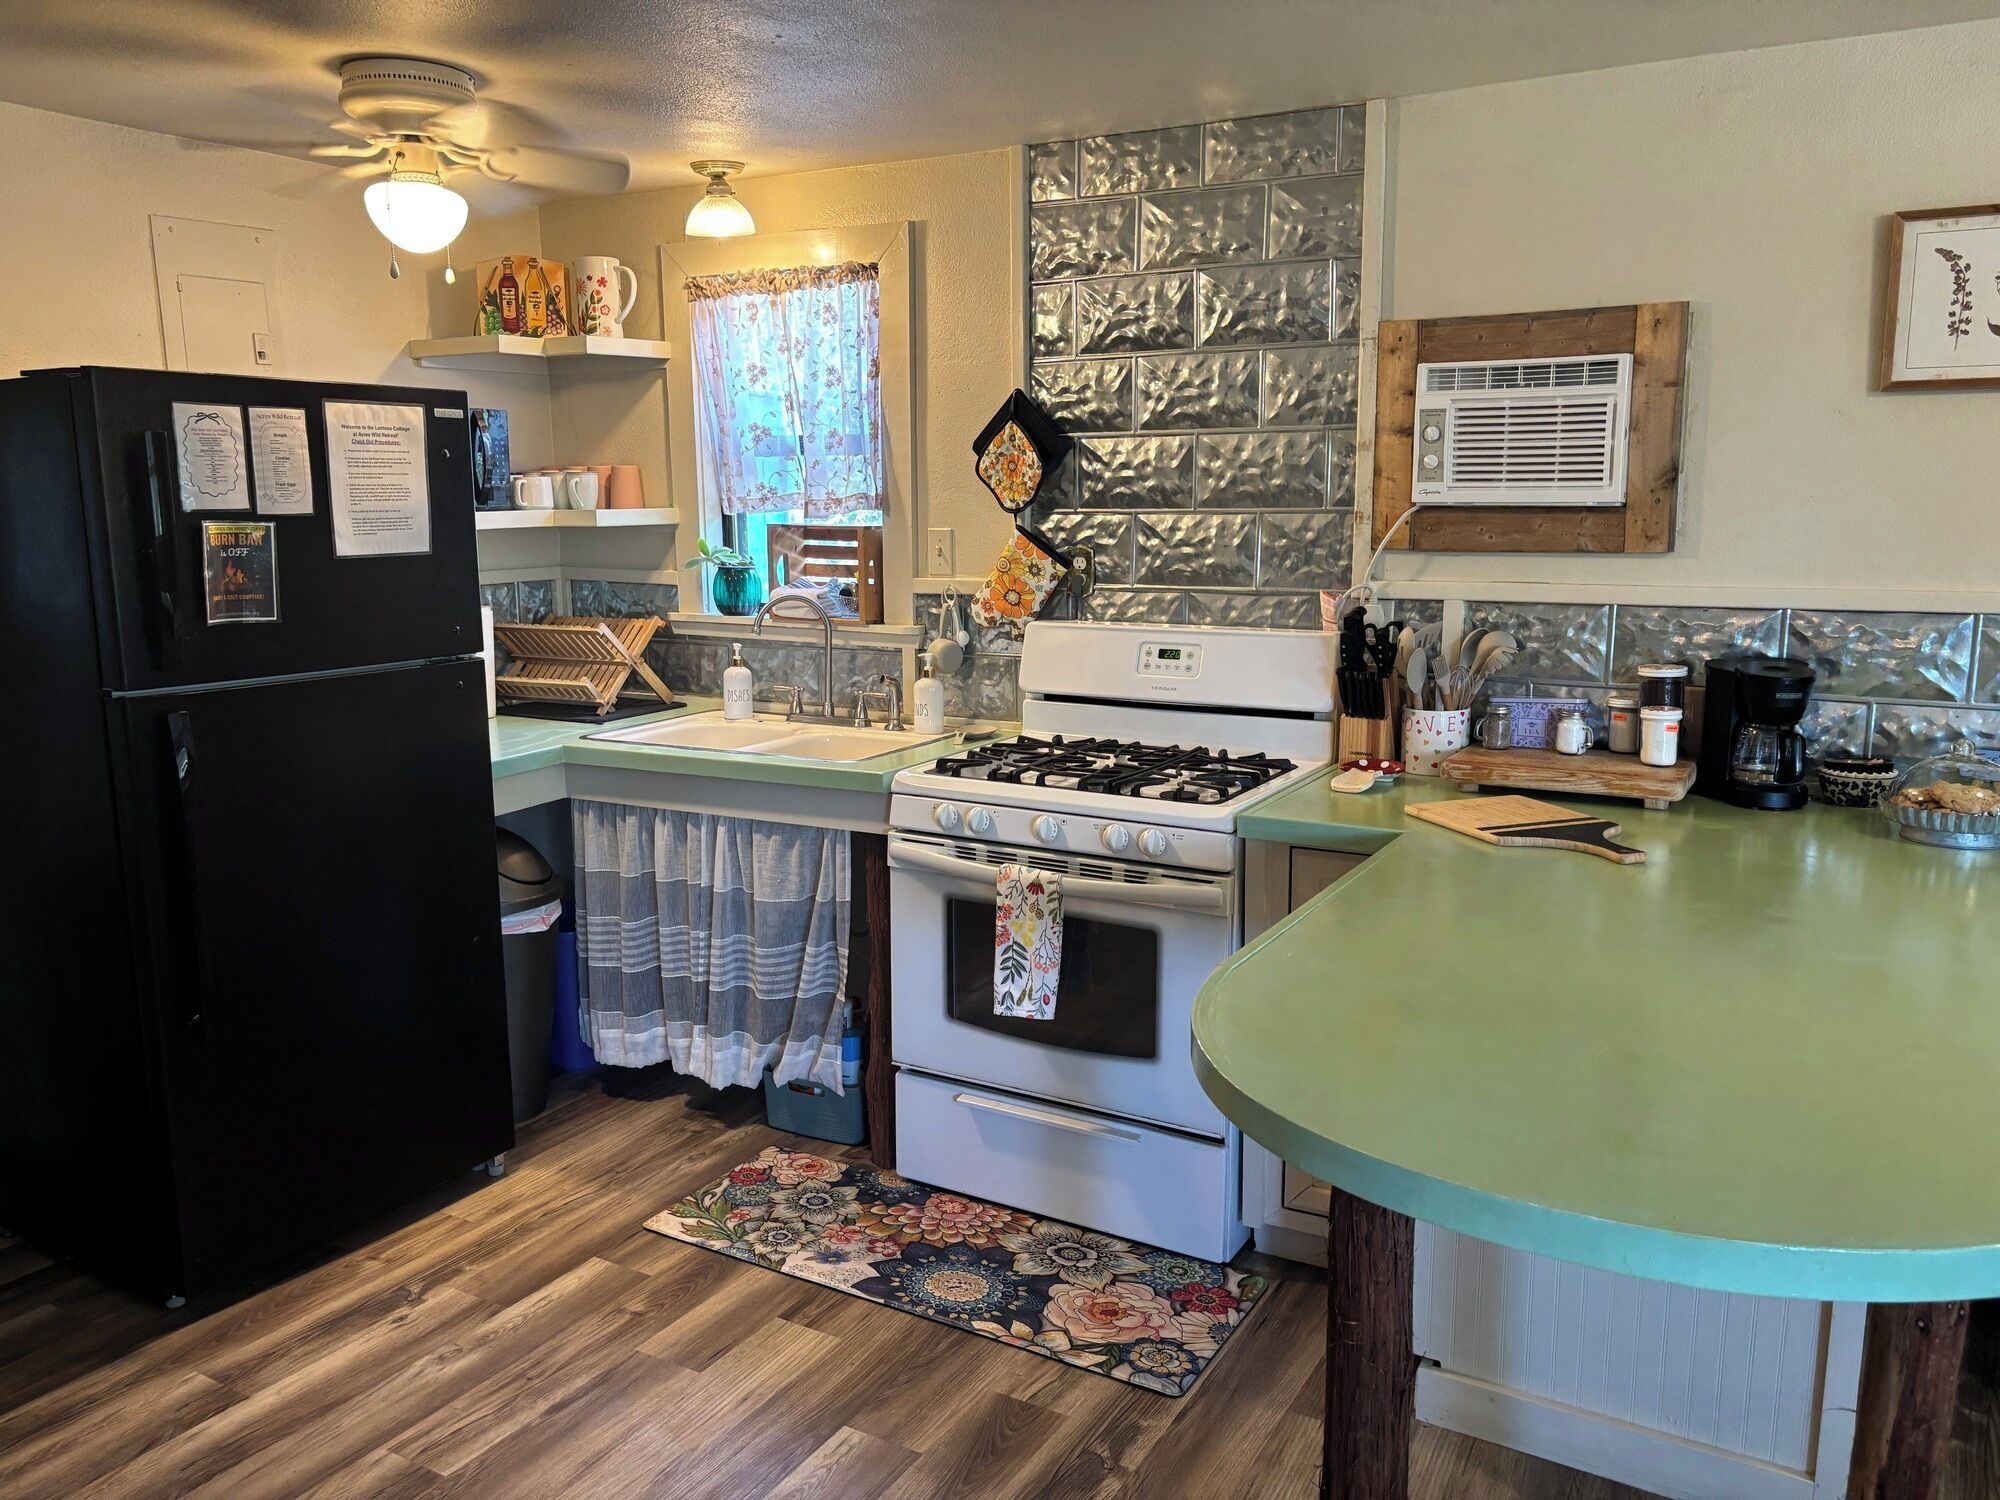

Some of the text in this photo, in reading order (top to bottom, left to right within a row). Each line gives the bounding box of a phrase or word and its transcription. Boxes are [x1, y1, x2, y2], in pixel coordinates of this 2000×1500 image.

[210, 534, 262, 546] BURN BAN
[228, 548, 250, 556] OFF
[728, 689, 750, 702] DISHES
